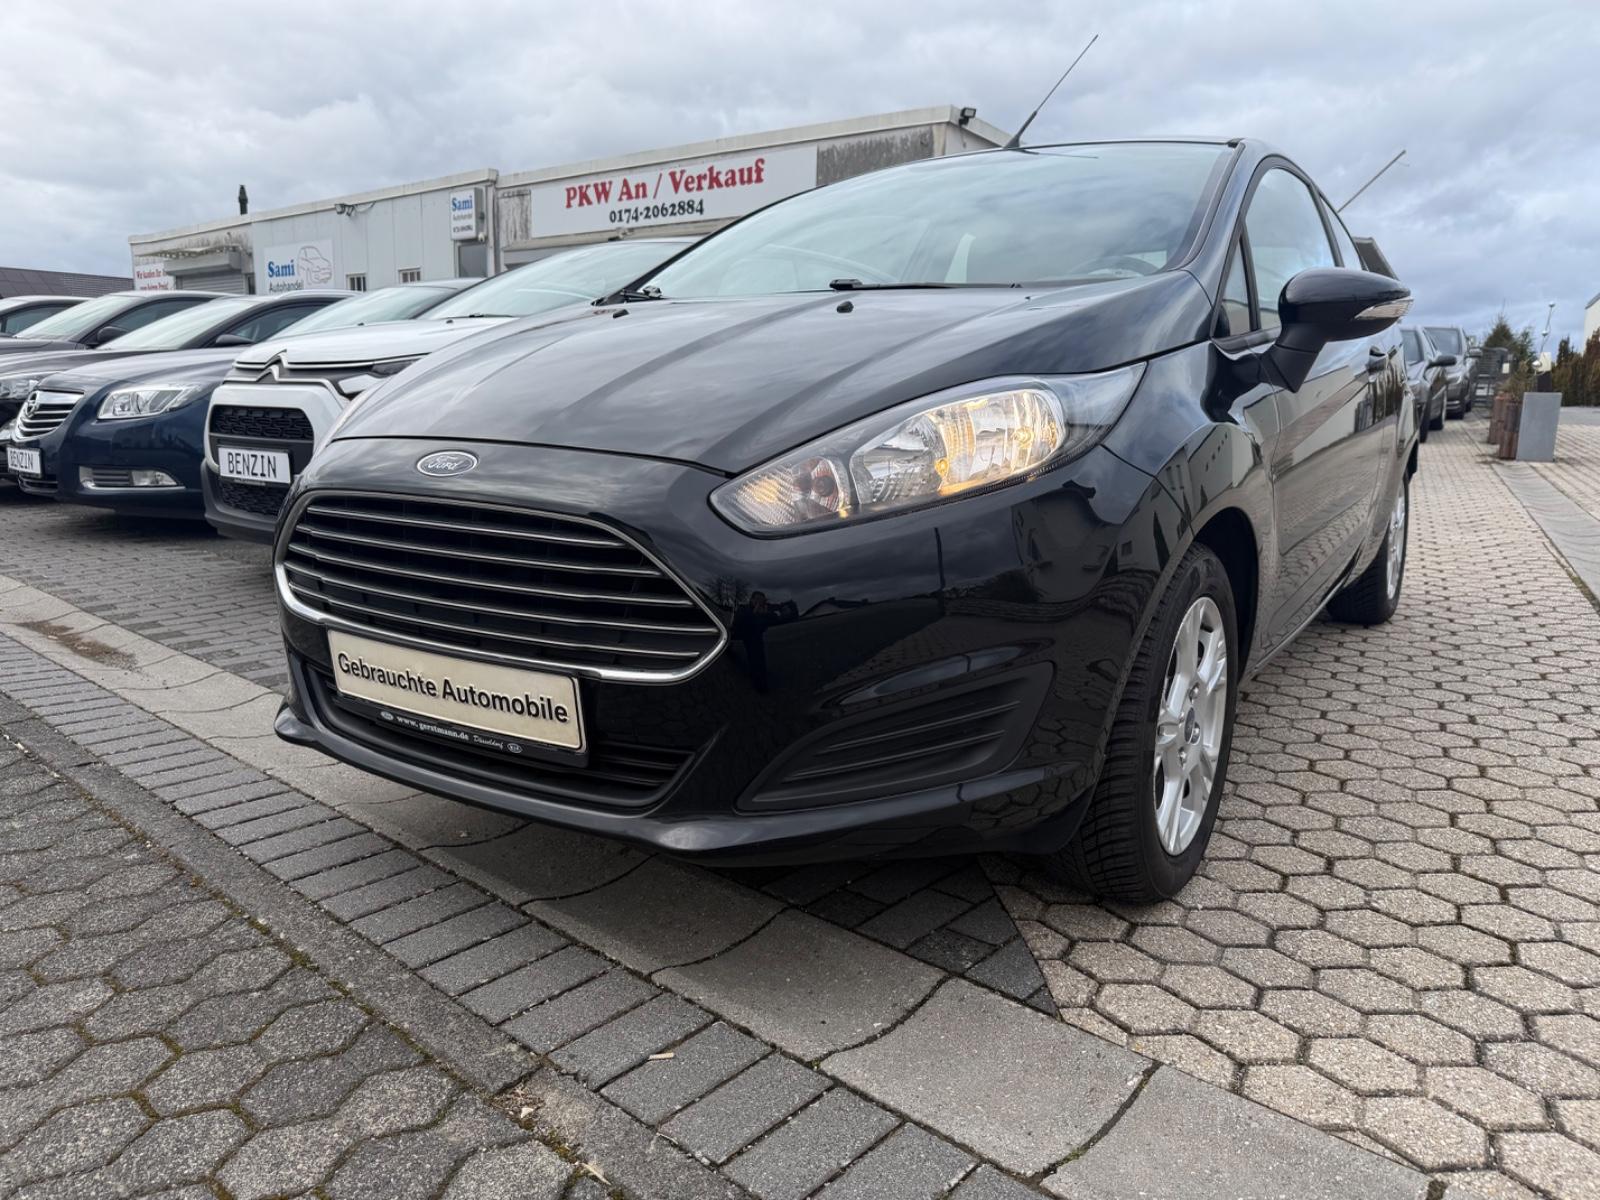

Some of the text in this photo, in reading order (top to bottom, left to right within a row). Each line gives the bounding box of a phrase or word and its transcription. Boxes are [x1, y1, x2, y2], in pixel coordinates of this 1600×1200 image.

[565, 180, 613, 209] PKW
[617, 177, 648, 202] An
[668, 157, 766, 195] Verkauf
[451, 195, 473, 212] Sami
[267, 258, 295, 278] Sami
[9, 450, 34, 470] BENZIN
[227, 452, 277, 479] BENZIN
[426, 455, 465, 471] Ford
[337, 652, 569, 724] Gebrauchte Automobile
